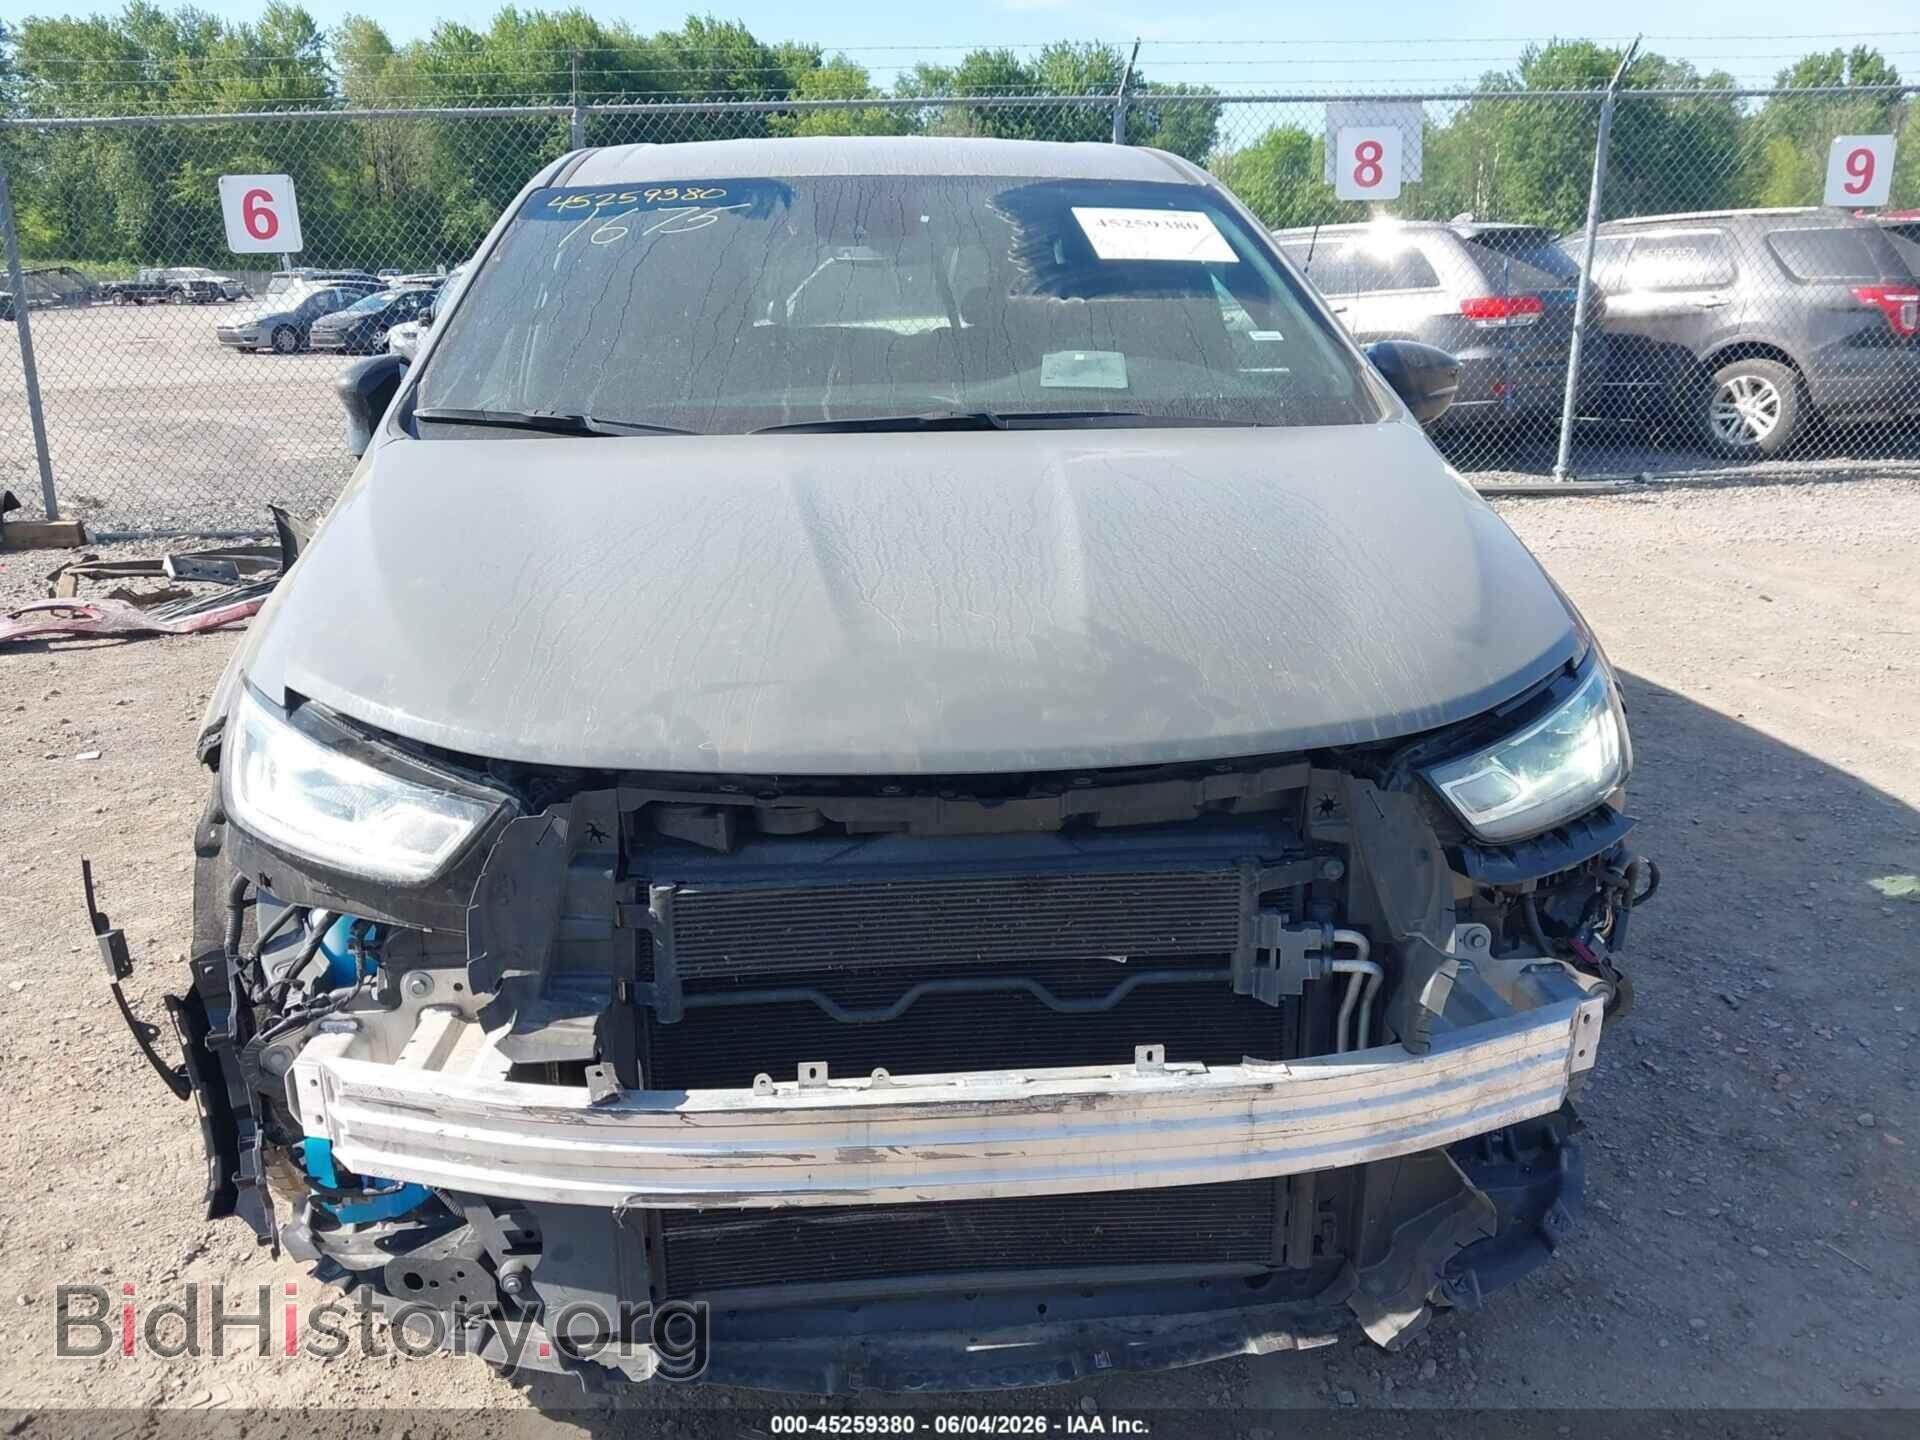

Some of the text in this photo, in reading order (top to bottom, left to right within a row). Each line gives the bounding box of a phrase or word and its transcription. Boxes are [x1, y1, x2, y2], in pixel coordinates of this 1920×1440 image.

[1354, 141, 1383, 187] 8
[1844, 149, 1875, 194] 9
[243, 189, 279, 240] 6
[547, 188, 727, 212] 45259380
